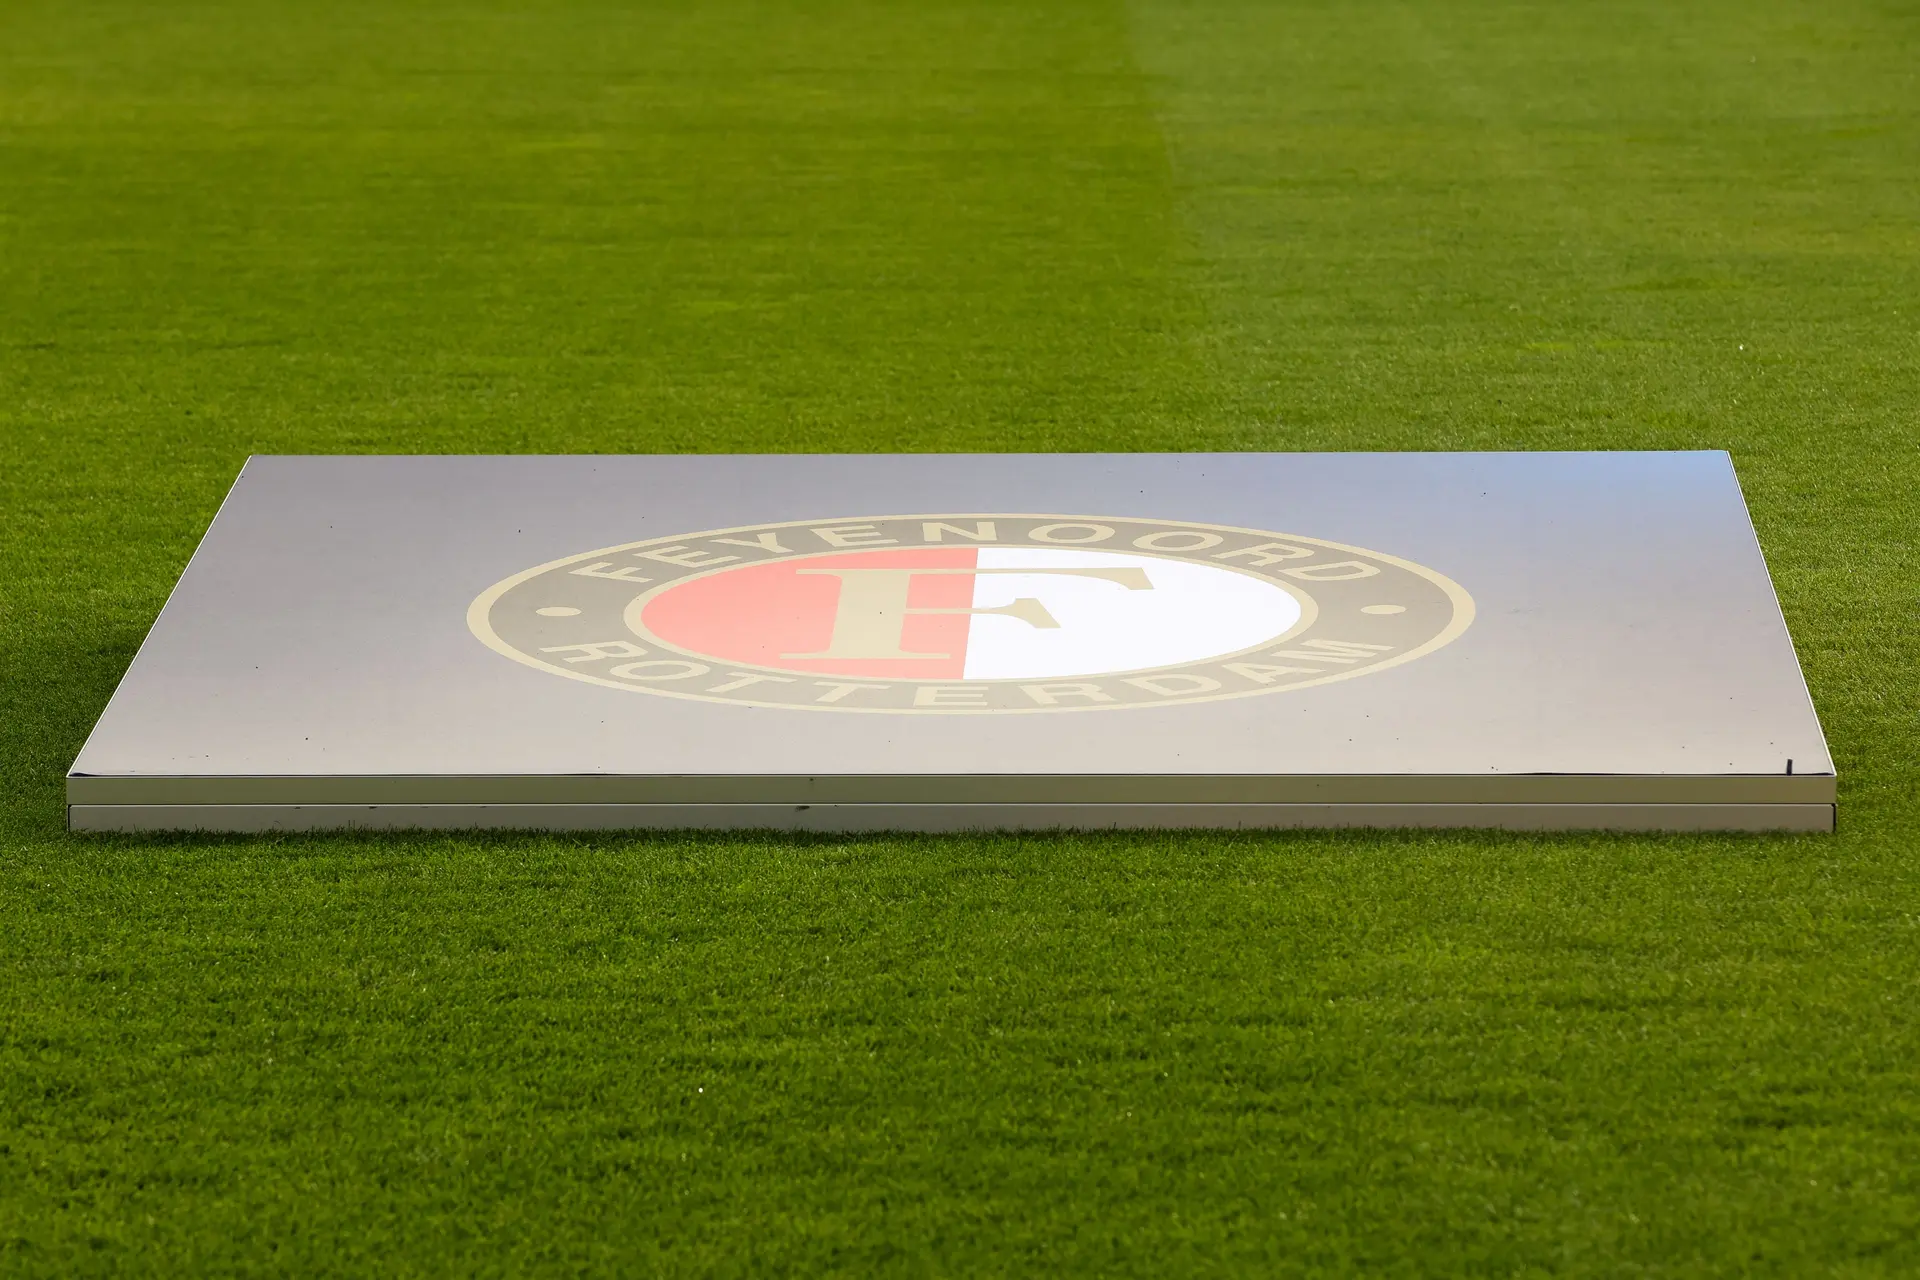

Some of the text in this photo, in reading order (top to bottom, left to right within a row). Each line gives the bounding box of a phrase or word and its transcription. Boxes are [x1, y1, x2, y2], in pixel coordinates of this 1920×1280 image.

[568, 521, 1381, 583] FEYENOORD
[779, 567, 1155, 659] F
[539, 638, 1396, 707] ROTTERDAM
